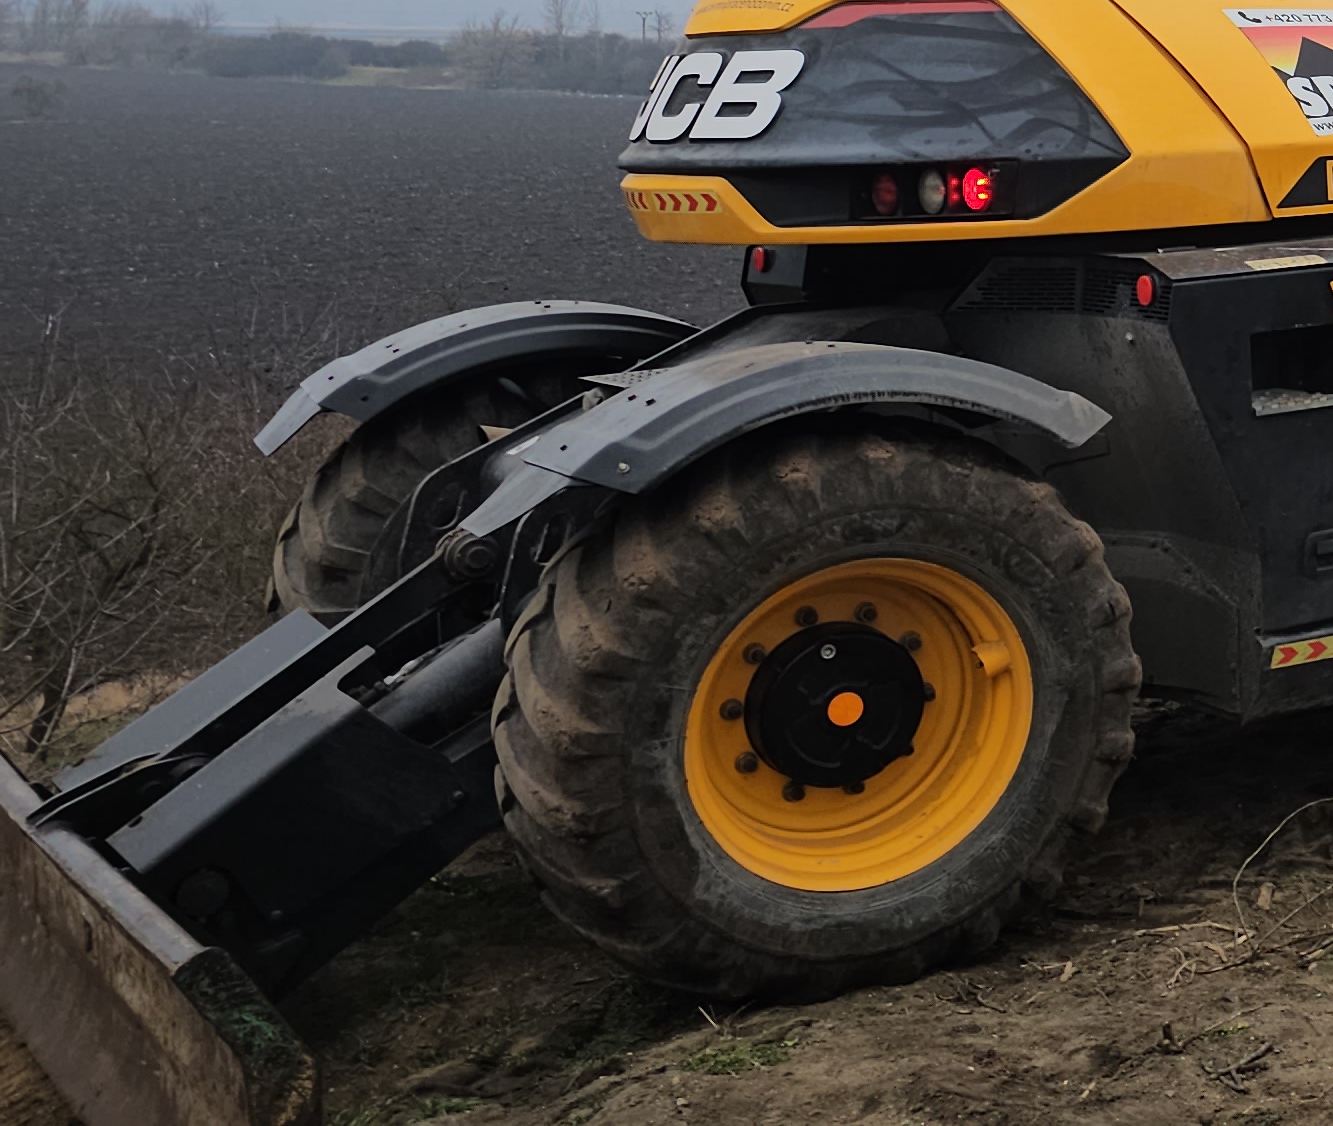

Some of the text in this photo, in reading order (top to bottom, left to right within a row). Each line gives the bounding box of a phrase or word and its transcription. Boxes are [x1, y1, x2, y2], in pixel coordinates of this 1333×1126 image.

[1265, 13, 1302, 23] +420
[1302, 13, 1332, 23] 773
[629, 50, 805, 140] JCB
